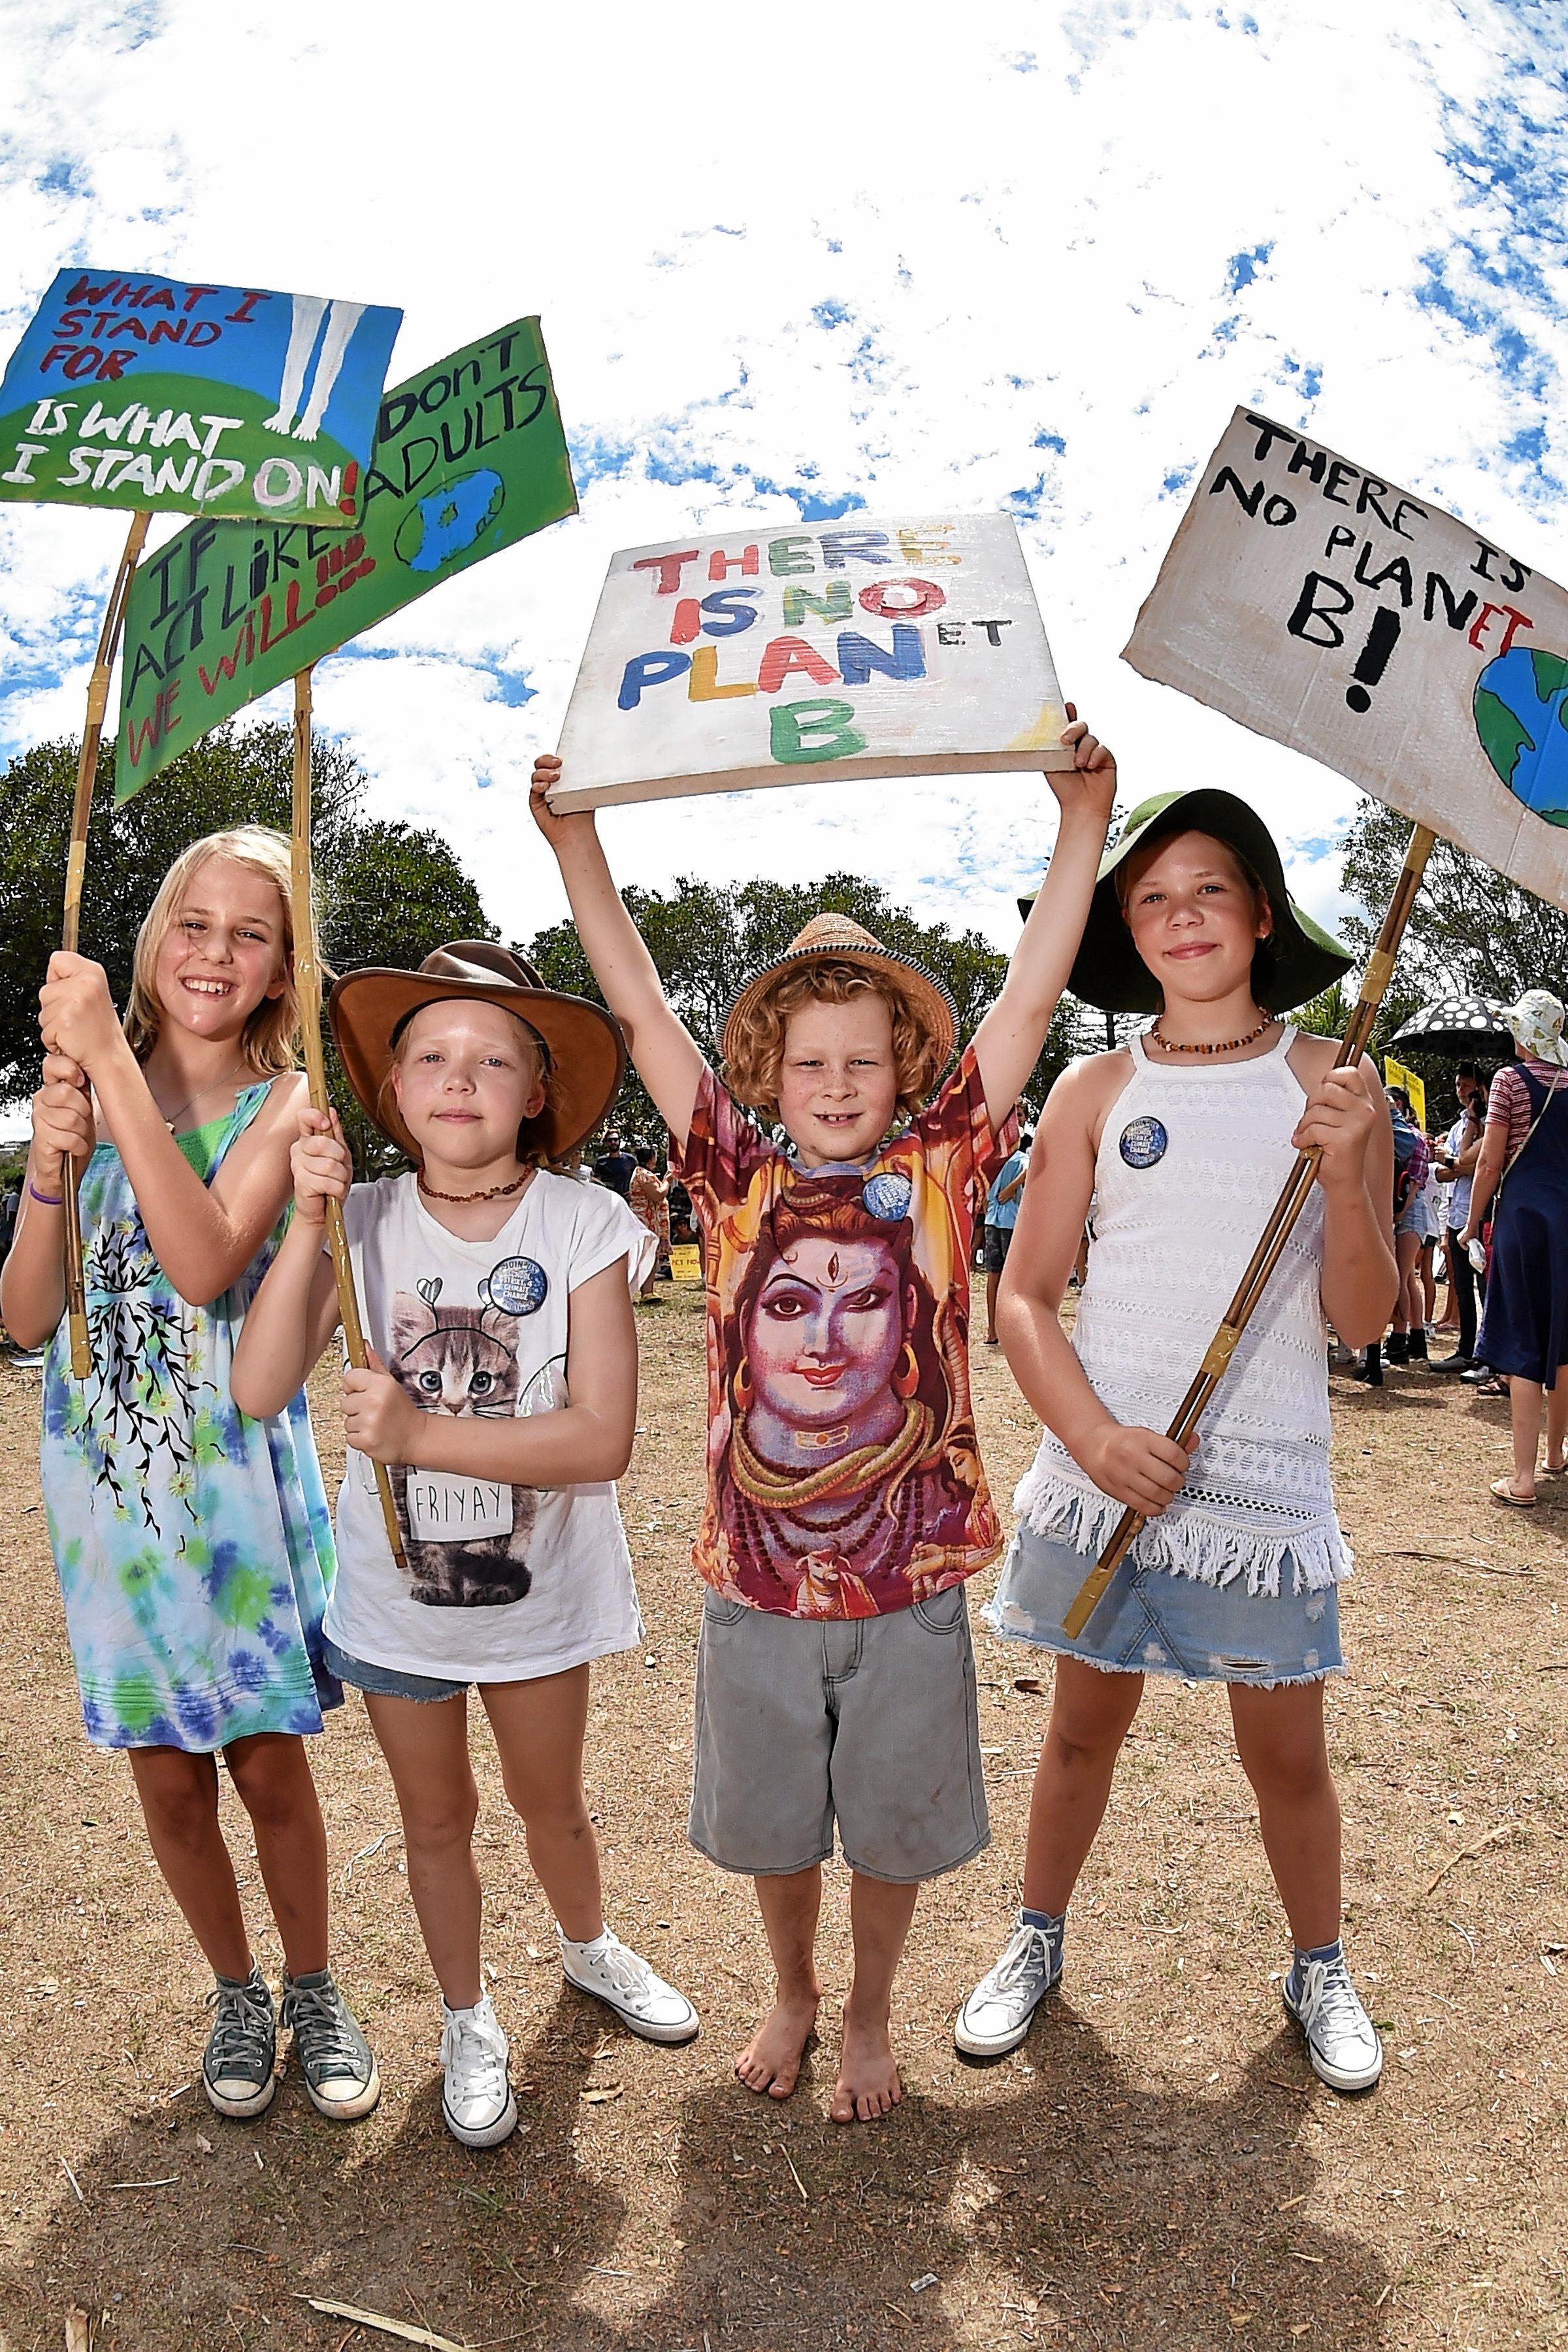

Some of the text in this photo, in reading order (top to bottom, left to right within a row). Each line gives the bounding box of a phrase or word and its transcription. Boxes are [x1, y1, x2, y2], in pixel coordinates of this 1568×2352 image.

[53, 308, 222, 347] STAND
[64, 274, 270, 323] WHAT I
[39, 344, 137, 380] FOR
[25, 398, 244, 459] IS WHAT
[1, 443, 359, 515] I STAND ON!
[1245, 413, 1532, 593] THERE IS
[125, 585, 210, 708] ACT
[363, 363, 547, 502] ADULTS
[630, 523, 962, 594] THERE
[1209, 465, 1534, 658] NO PLANET
[150, 519, 220, 630] IF
[669, 578, 947, 645] IS NO
[1286, 570, 1401, 713] B!
[128, 679, 182, 767] WE
[769, 698, 868, 764] B
[416, 1484, 500, 1522] FRIYAY
